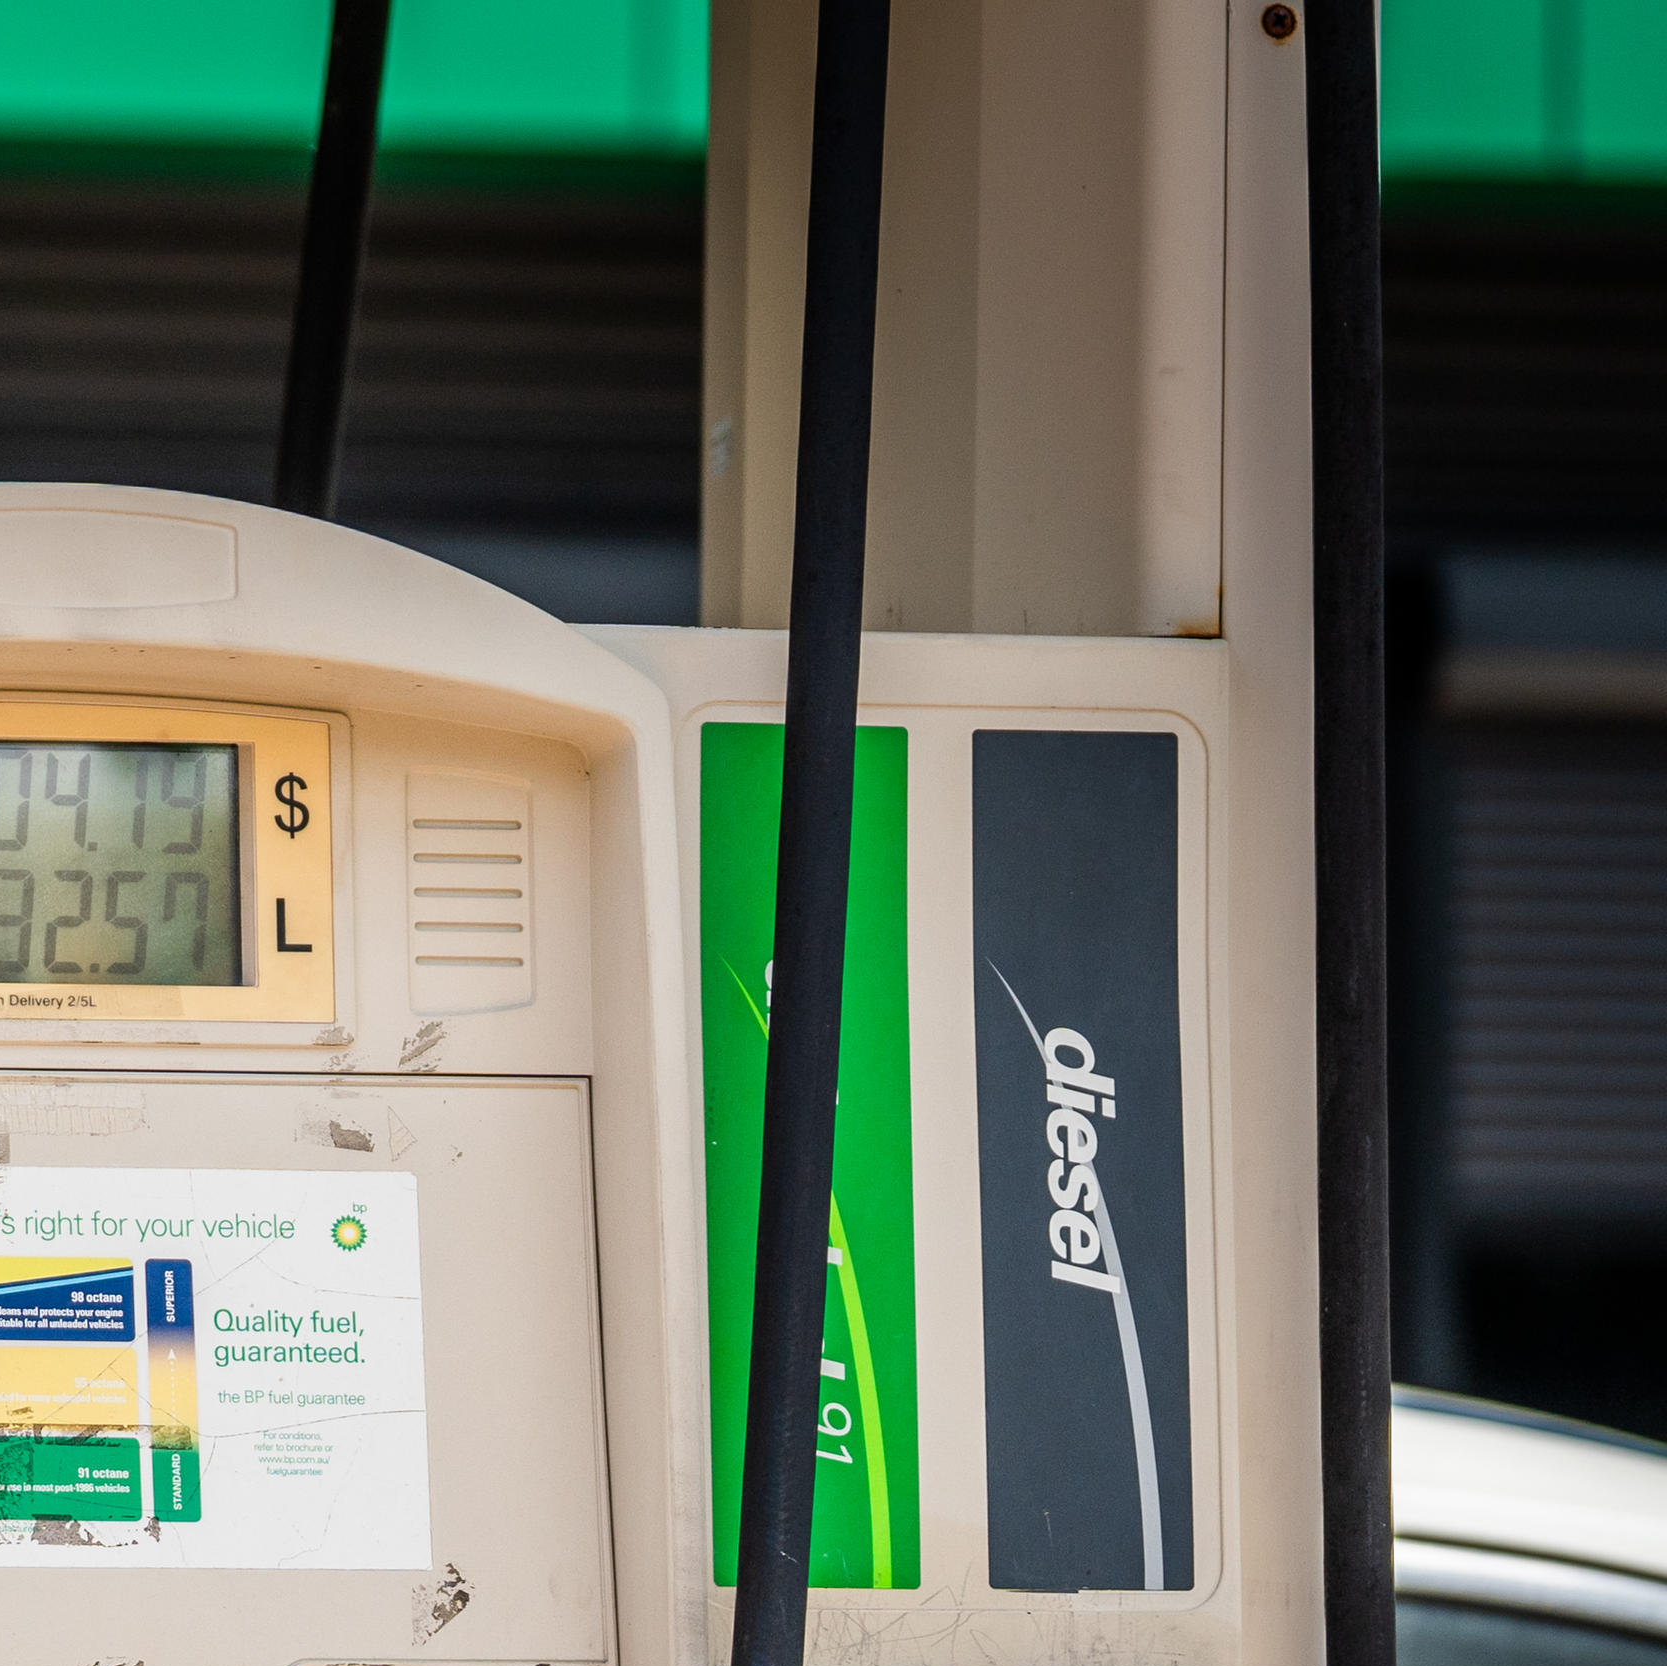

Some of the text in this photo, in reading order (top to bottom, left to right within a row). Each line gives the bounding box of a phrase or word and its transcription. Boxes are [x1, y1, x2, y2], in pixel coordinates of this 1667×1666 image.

[274, 773, 310, 839] $
[276, 897, 312, 953] L
[9, 994, 63, 1009] Delivery
[67, 995, 97, 1007] 2/5L
[1043, 1026, 1122, 1293] diesel
[352, 1202, 367, 1214] bp
[24, 1209, 84, 1241] right
[91, 1210, 128, 1237] for
[135, 1218, 194, 1242] your
[202, 1213, 296, 1240] vehicle
[71, 1291, 123, 1303] 98 octane
[166, 1270, 175, 1322] SUPERIOR
[23, 1306, 38, 1316] and
[39, 1307, 74, 1318] protects
[75, 1309, 94, 1318] your
[95, 1308, 123, 1319] engine
[24, 1318, 36, 1328] for
[37, 1318, 48, 1328] all
[49, 1319, 88, 1329] unleaded
[89, 1319, 124, 1329] vehicles
[213, 1308, 364, 1338] Quality fuel,
[214, 1341, 365, 1367] guaranteed.
[218, 1390, 365, 1407] the BP fuel guarantee
[263, 1431, 277, 1440] For
[816, 1400, 853, 1465] 91
[254, 1443, 274, 1451] refer
[275, 1443, 284, 1451] to
[285, 1443, 323, 1452] brochure
[77, 1467, 129, 1479] 91 octane
[32, 1483, 54, 1492] most
[54, 1483, 94, 1494] post-1986
[95, 1483, 130, 1493] vehicles
[173, 1453, 182, 1511] STANDARD
